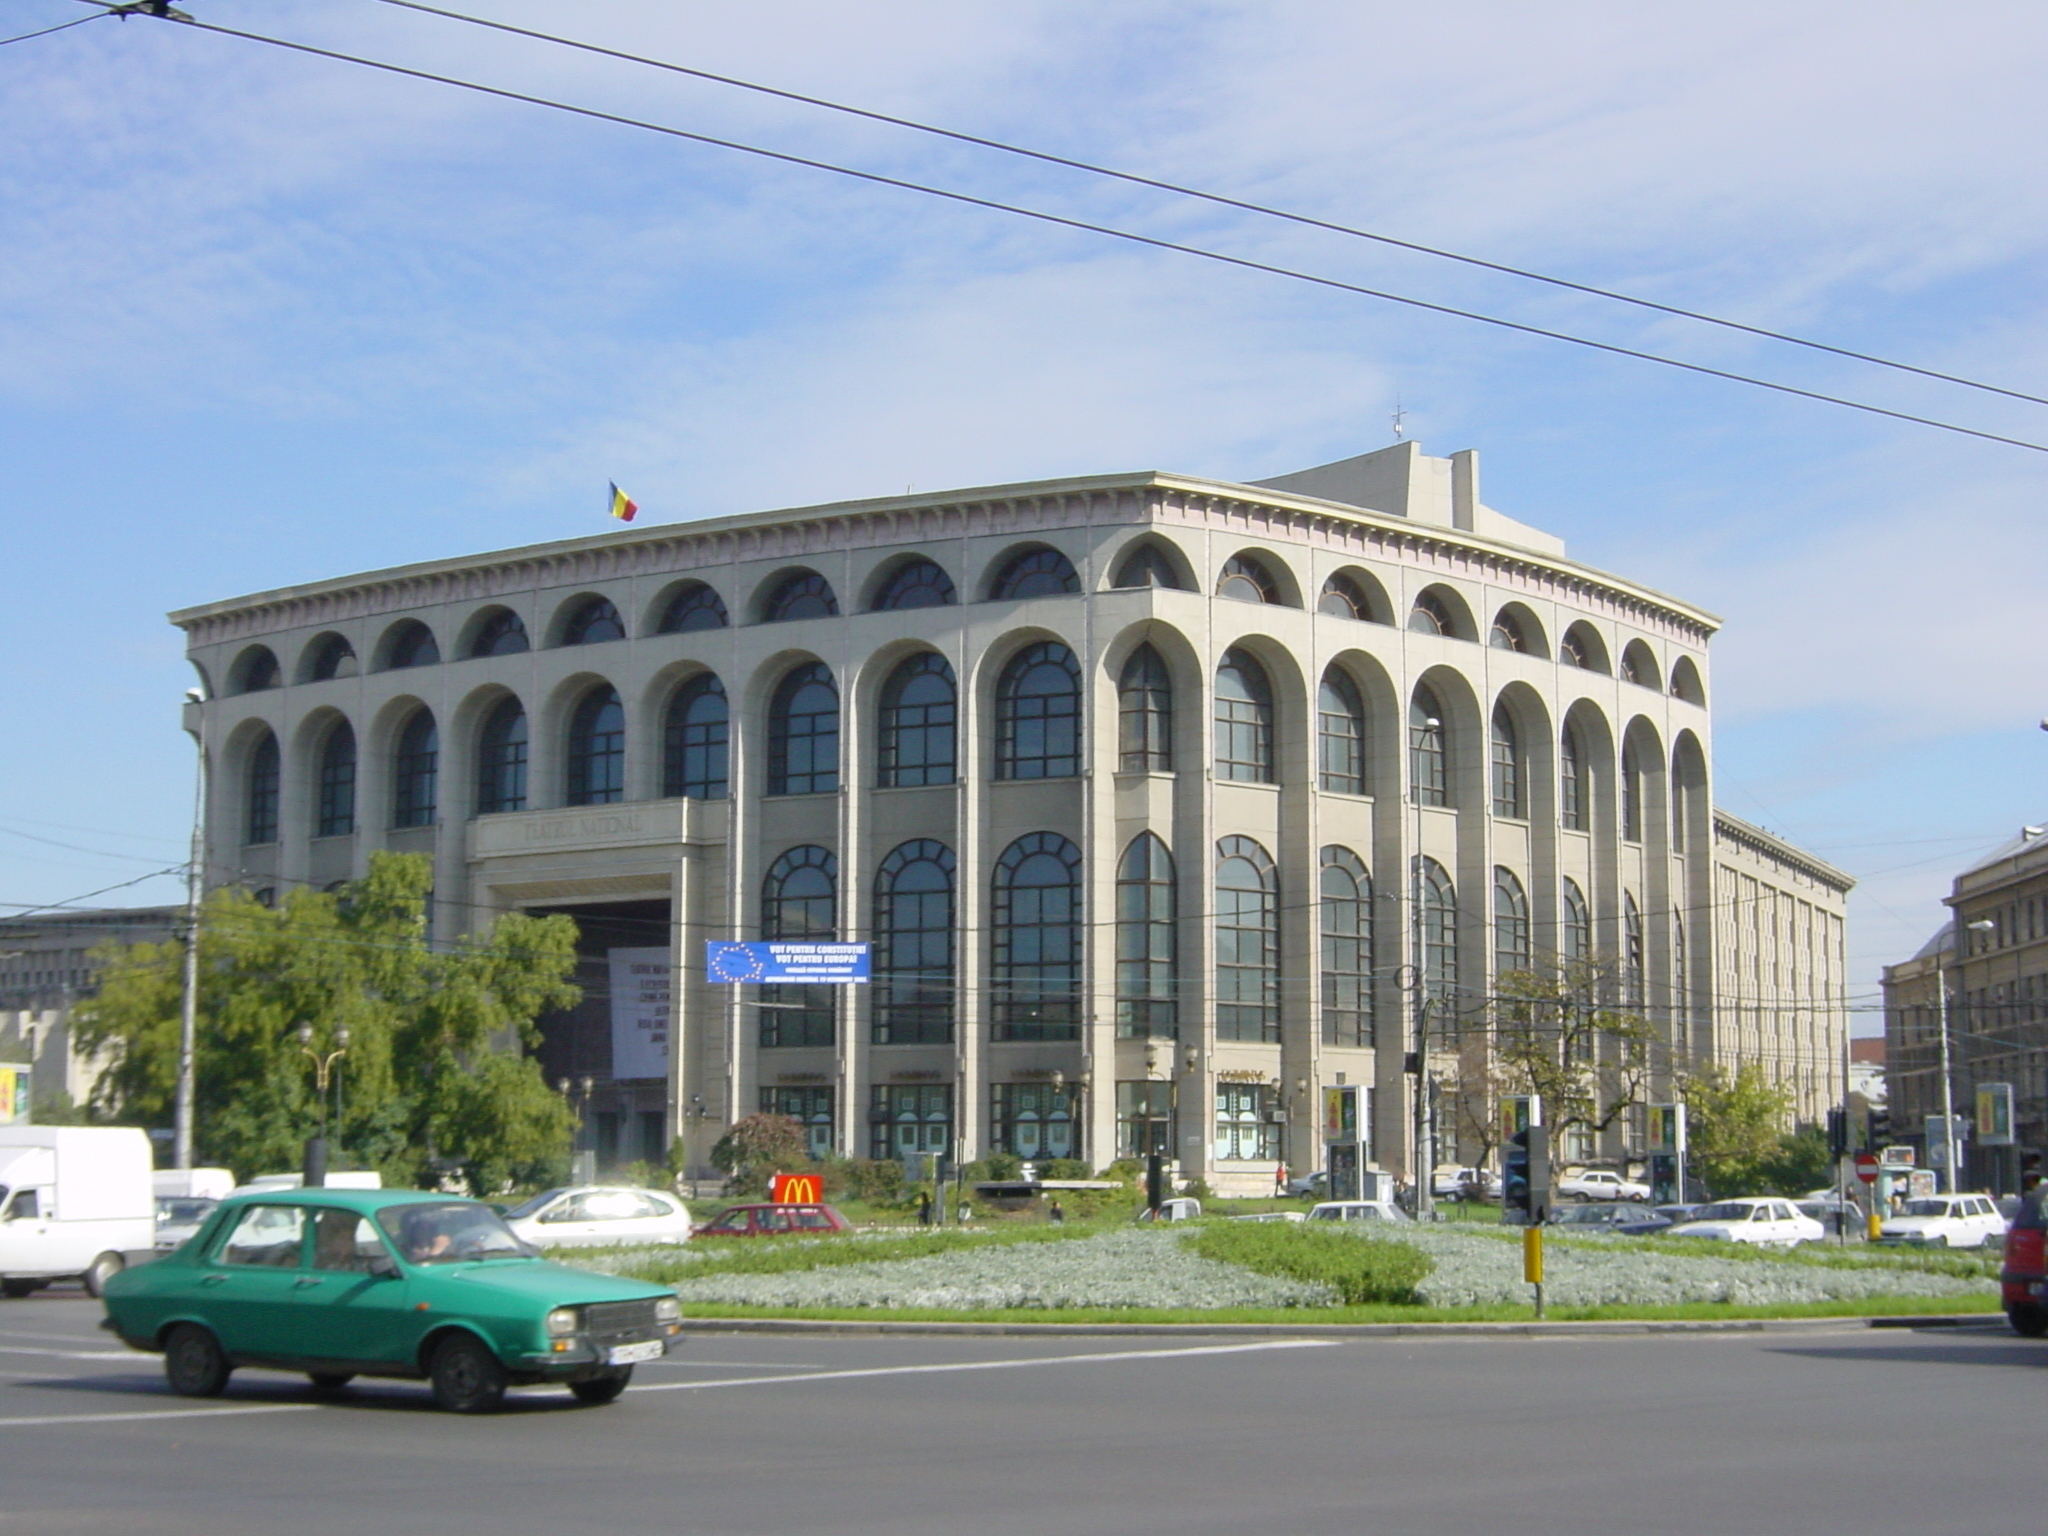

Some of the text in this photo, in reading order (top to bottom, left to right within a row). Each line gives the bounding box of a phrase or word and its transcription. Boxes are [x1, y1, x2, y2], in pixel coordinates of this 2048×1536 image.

[769, 945, 786, 954] VOT
[786, 945, 815, 954] PENTRU
[776, 954, 791, 964] VOT
[792, 954, 822, 964] PENTRU
